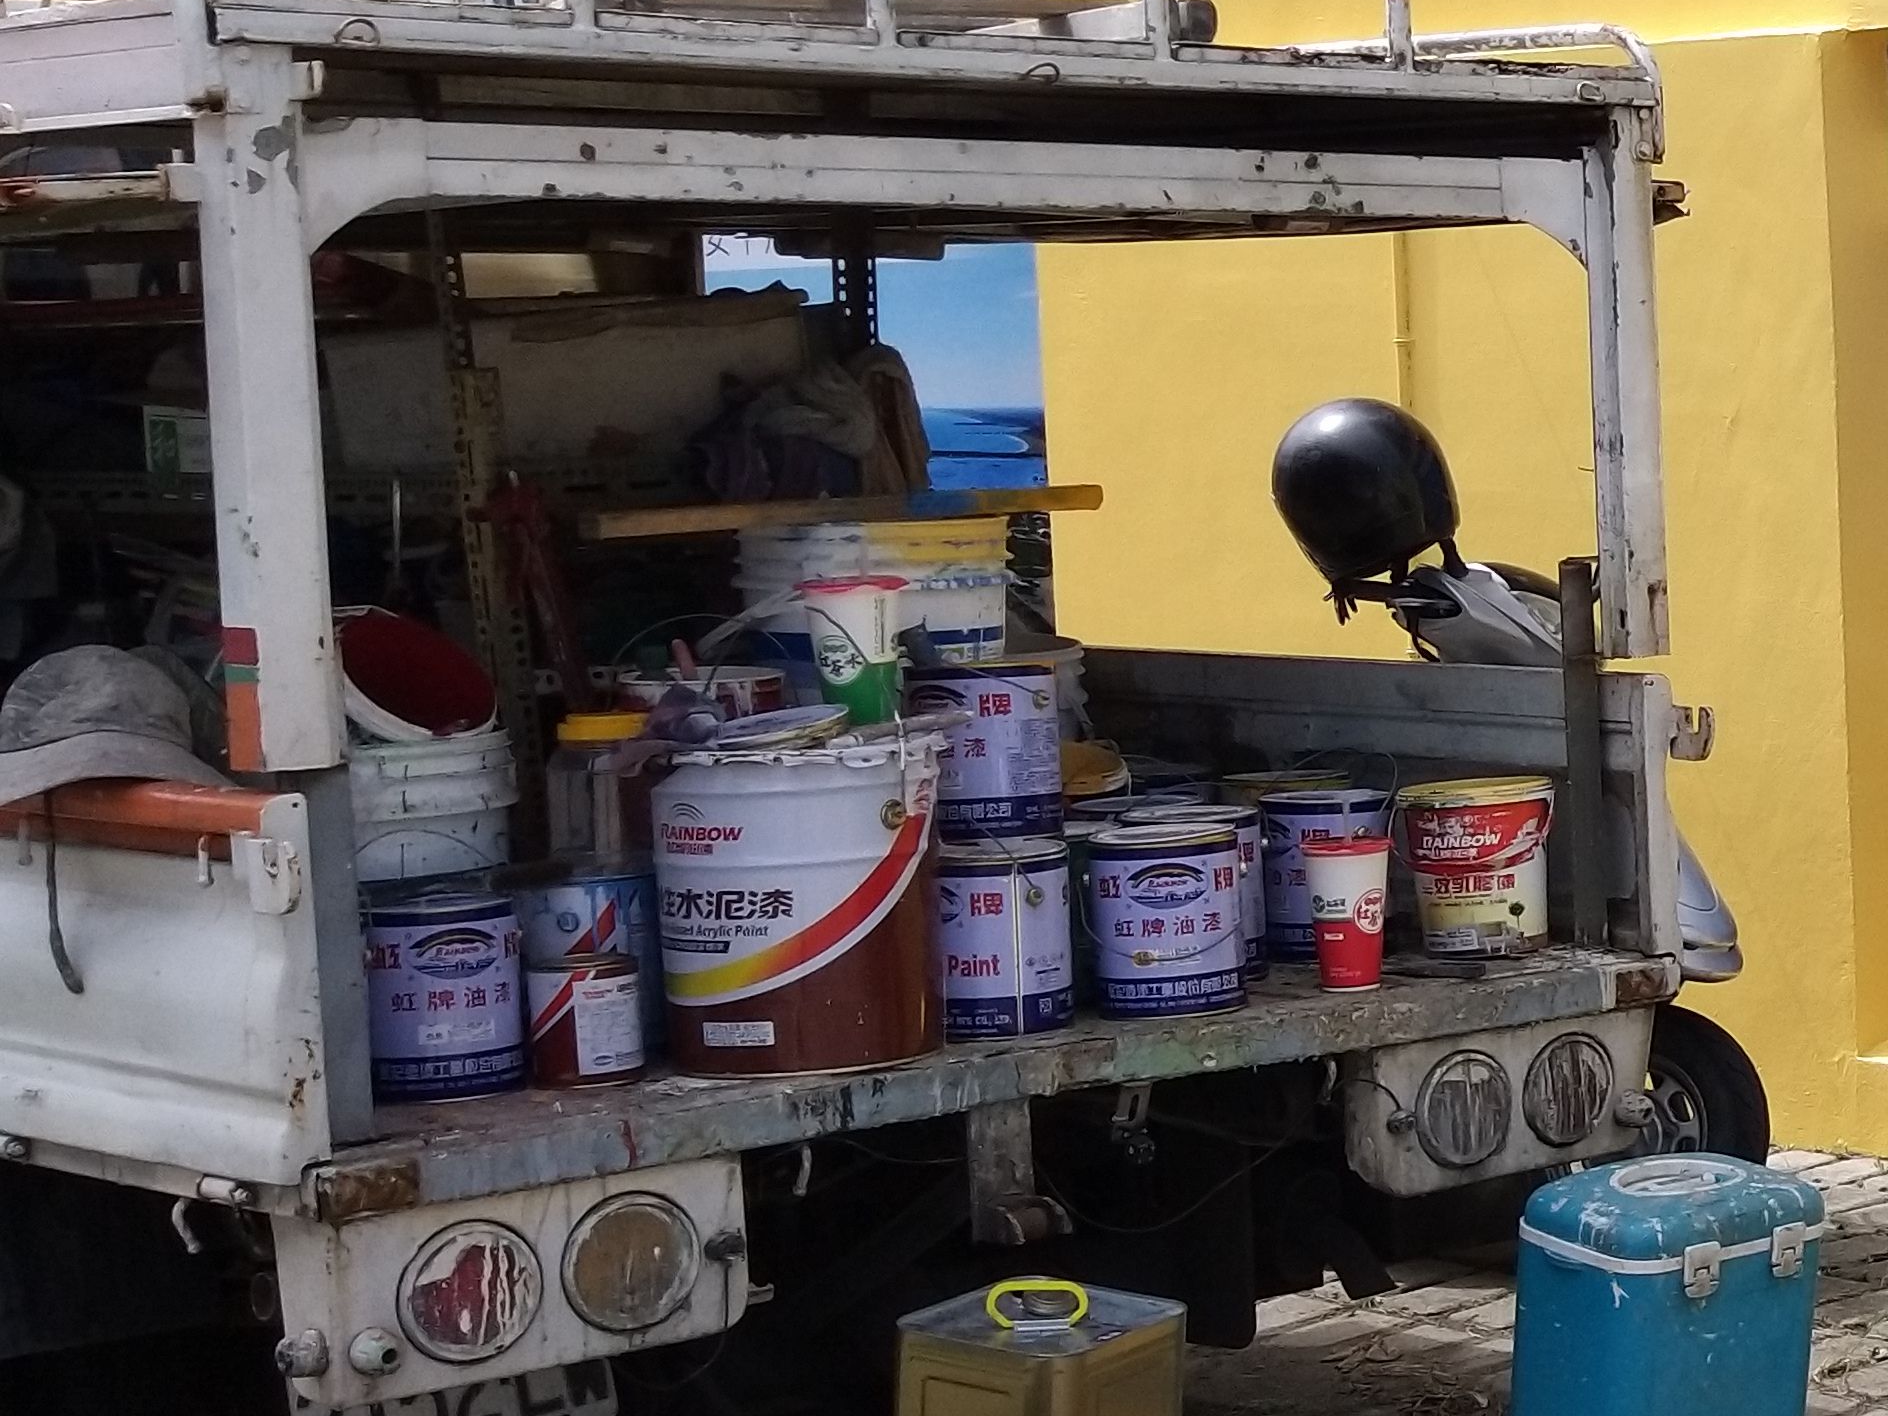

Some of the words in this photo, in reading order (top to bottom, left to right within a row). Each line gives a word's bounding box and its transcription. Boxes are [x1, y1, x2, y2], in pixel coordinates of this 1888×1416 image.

[660, 823, 744, 842] RAINBOW
[695, 924, 732, 939] Acrylic
[734, 925, 770, 938] Paint
[947, 953, 1001, 977] Paint
